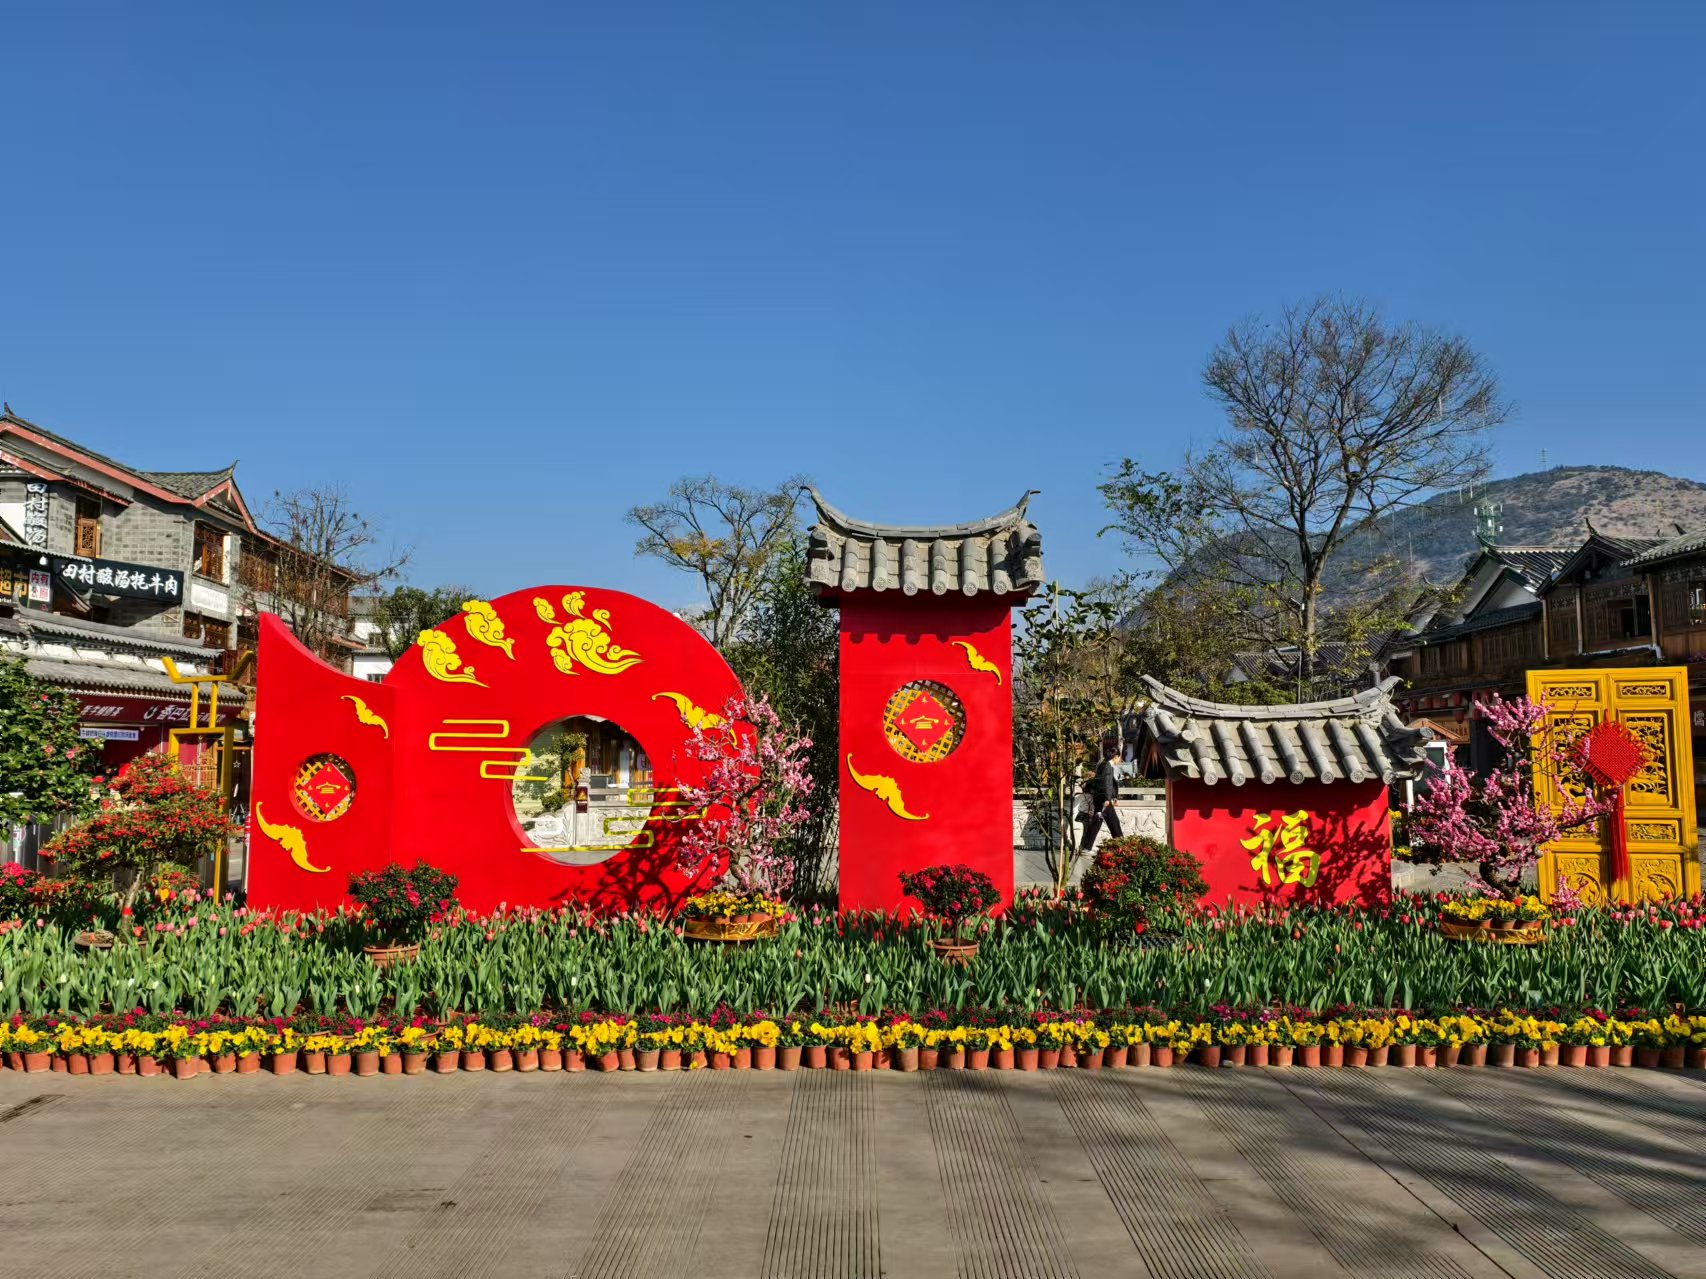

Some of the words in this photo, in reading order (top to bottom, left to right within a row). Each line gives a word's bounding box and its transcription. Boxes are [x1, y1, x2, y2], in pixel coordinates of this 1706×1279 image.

[62, 563, 178, 596] 田村酸汤牦牛肉
[1240, 810, 1320, 887] 福
